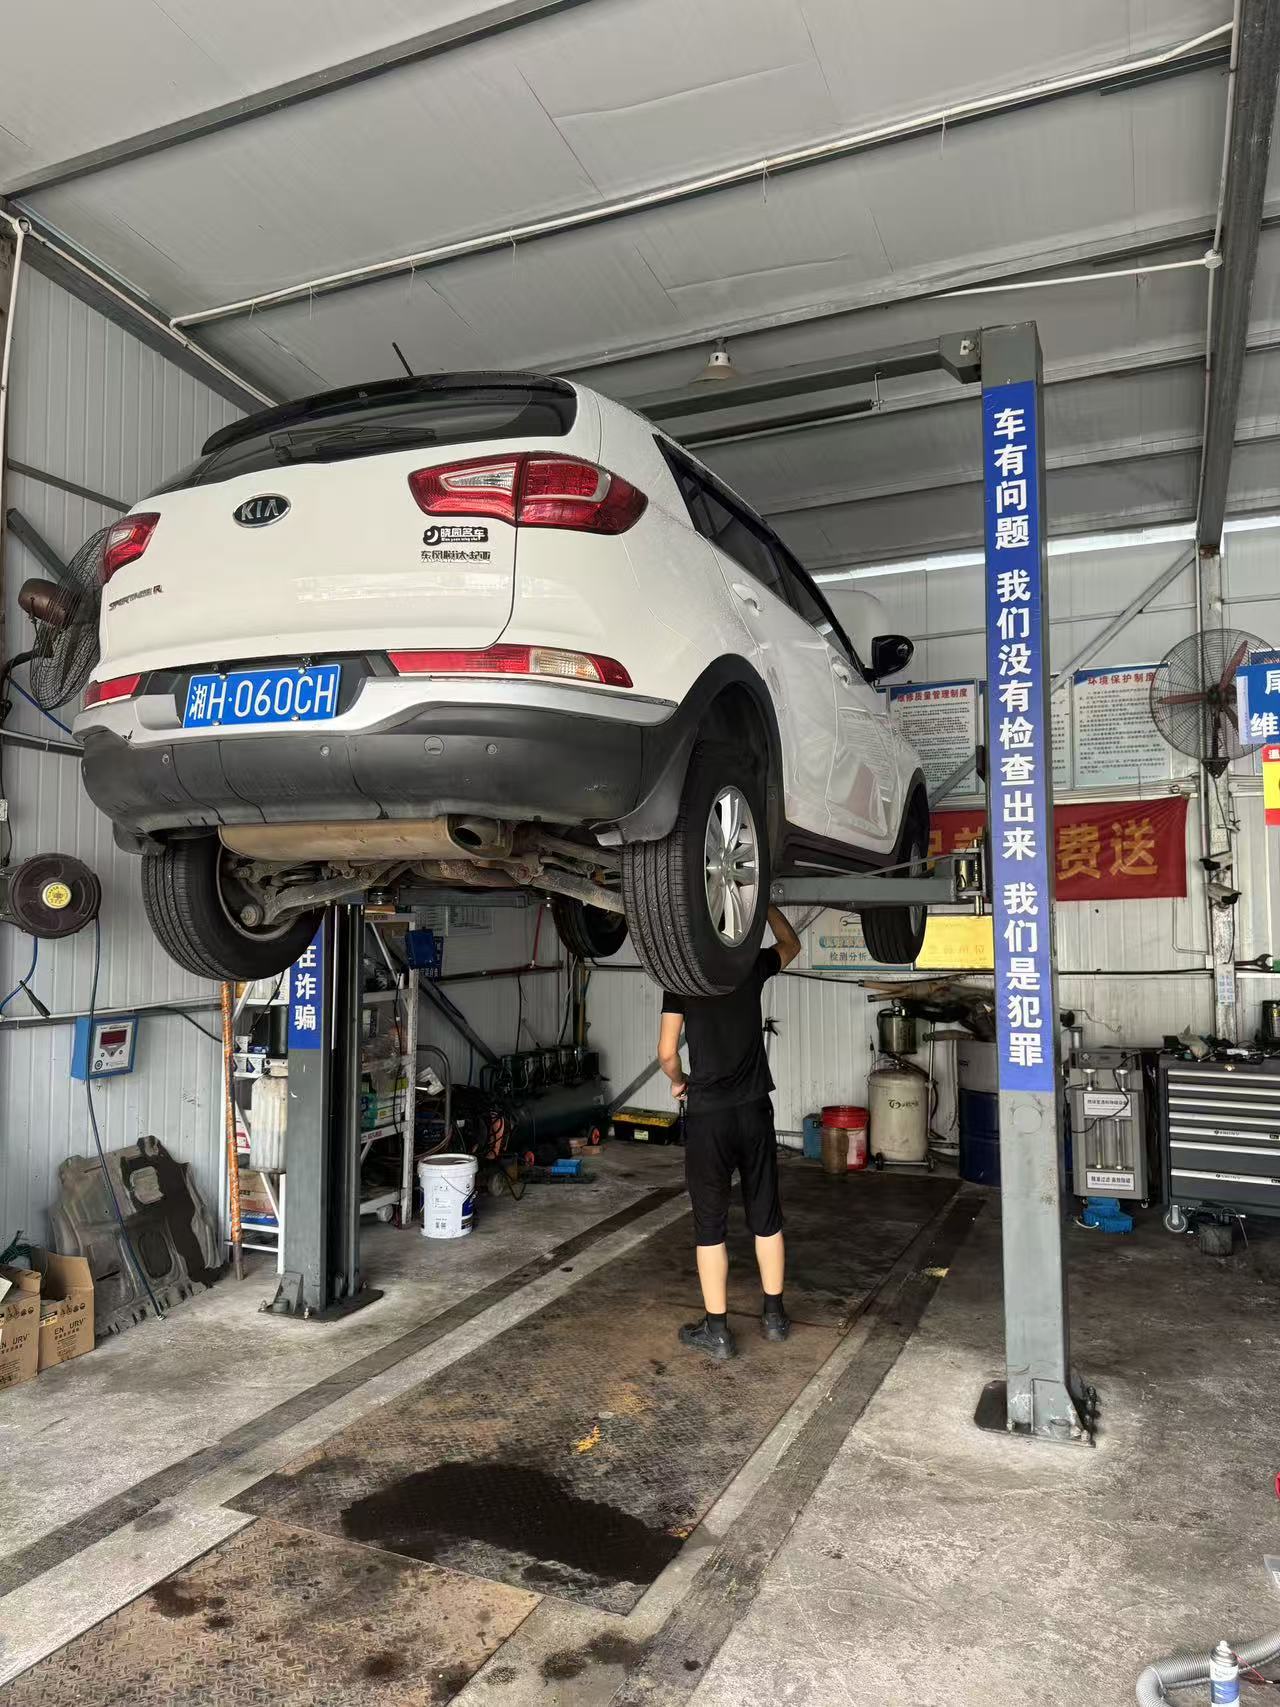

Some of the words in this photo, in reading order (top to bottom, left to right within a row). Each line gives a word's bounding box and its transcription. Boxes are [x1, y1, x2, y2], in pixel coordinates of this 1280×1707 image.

[241, 499, 280, 520] KIA
[994, 408, 1030, 550] 车有问题
[996, 569, 1037, 861] 我们没有检查出来
[830, 951, 873, 961] 检测分析
[1003, 881, 1044, 1067] 我们是犯罪
